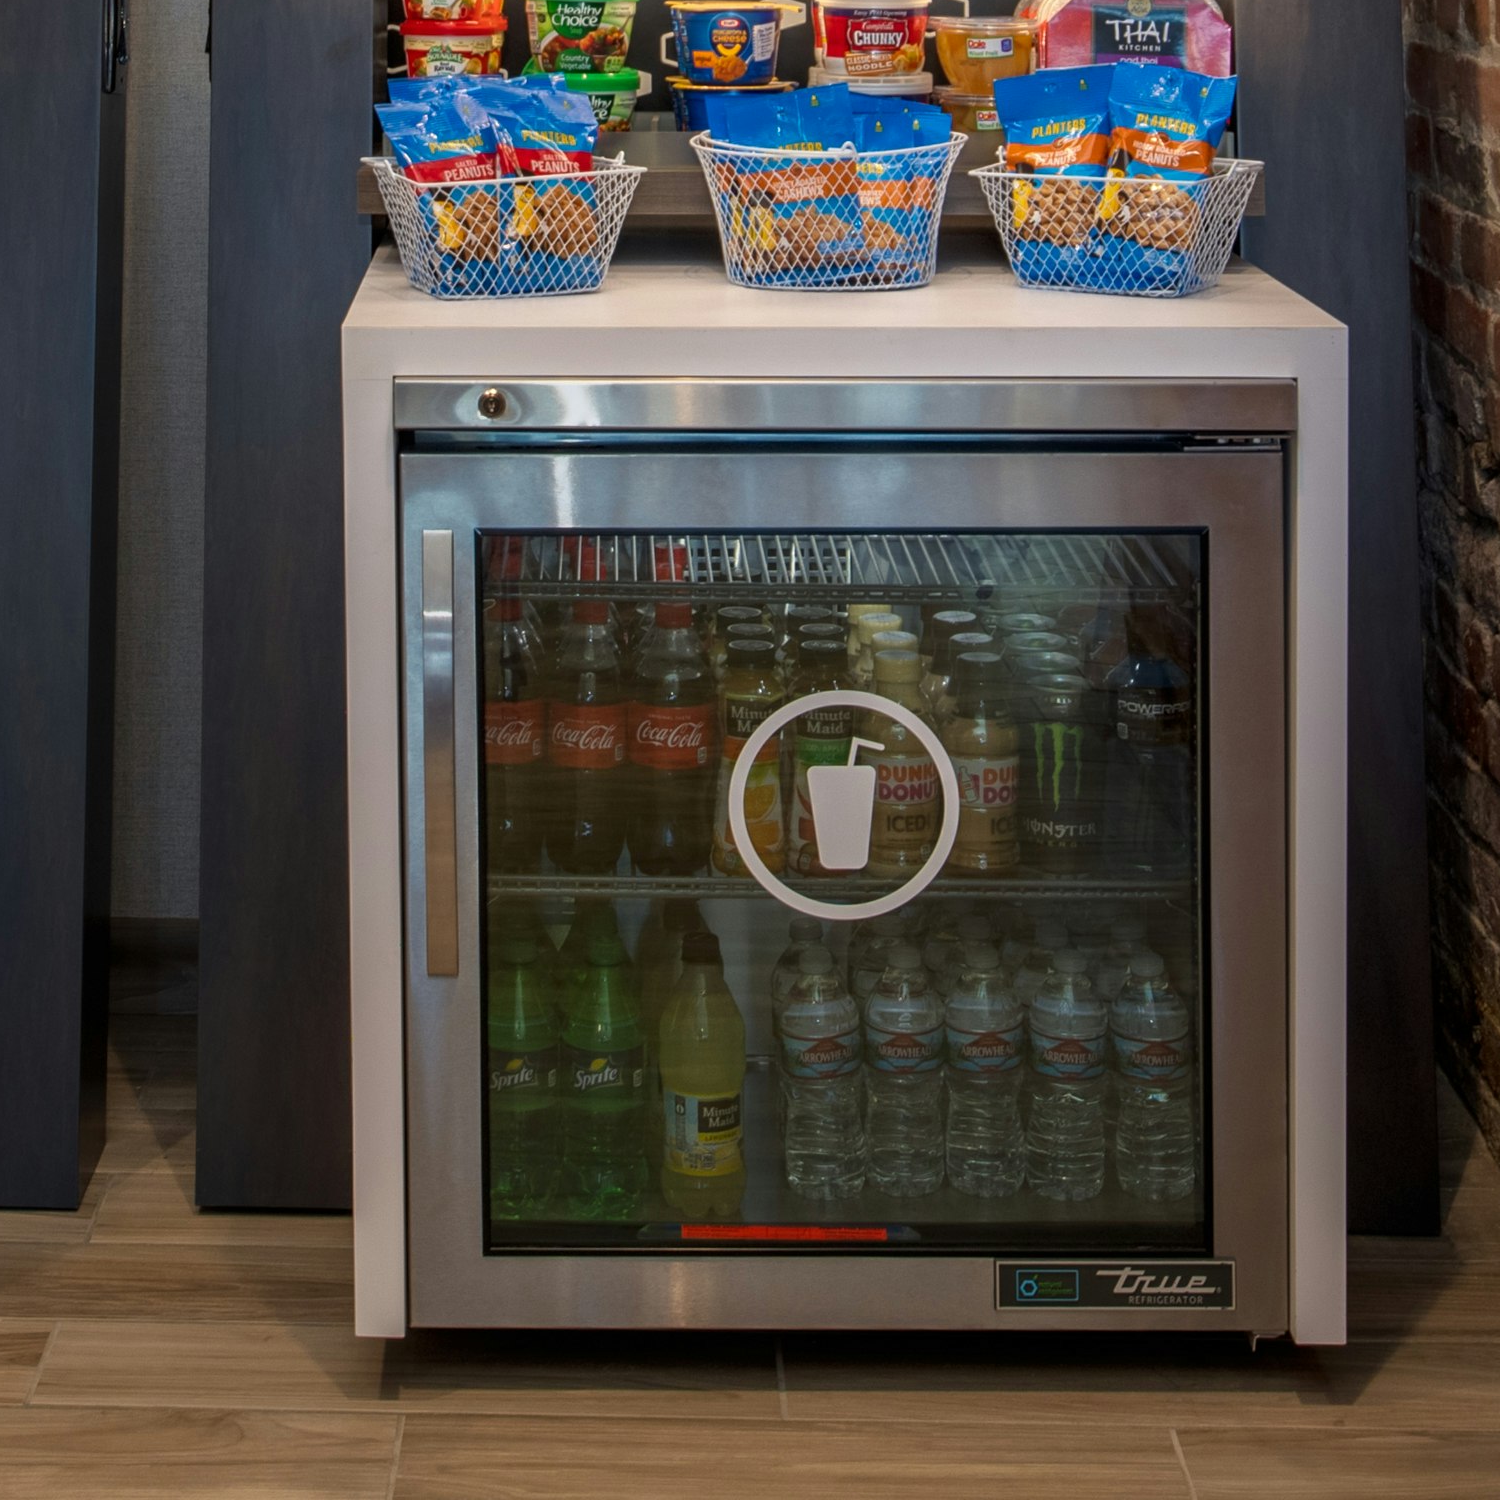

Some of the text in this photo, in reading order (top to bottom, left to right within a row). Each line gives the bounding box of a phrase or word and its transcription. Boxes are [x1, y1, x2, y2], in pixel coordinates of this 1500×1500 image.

[557, 2, 602, 16] Healthy
[552, 13, 598, 27] Choice
[854, 30, 904, 48] CHUNKY
[1105, 19, 1170, 44] THAI
[1118, 44, 1162, 52] KITCHEN
[560, 54, 590, 62] Country
[560, 62, 592, 71] Vegetable
[848, 61, 893, 72] NOODLE
[1031, 118, 1087, 139] PLANTERS
[1136, 113, 1196, 136] PLANTERS
[531, 160, 580, 174] PEANUTS
[1135, 149, 1181, 167] PEANUTS
[444, 164, 494, 182] PEANUTS
[1118, 699, 1190, 717] POWERAD
[553, 721, 617, 750] Coca-Cola
[637, 719, 704, 748] Coca-Cola
[807, 721, 845, 734] Maid
[878, 762, 937, 782] DUNK
[489, 1066, 533, 1091] Sprite
[574, 1066, 618, 1090] Sprite
[703, 1104, 738, 1118] Minute
[708, 1114, 735, 1128] Maid
[1128, 1295, 1203, 1304] REFRIGERATOR
